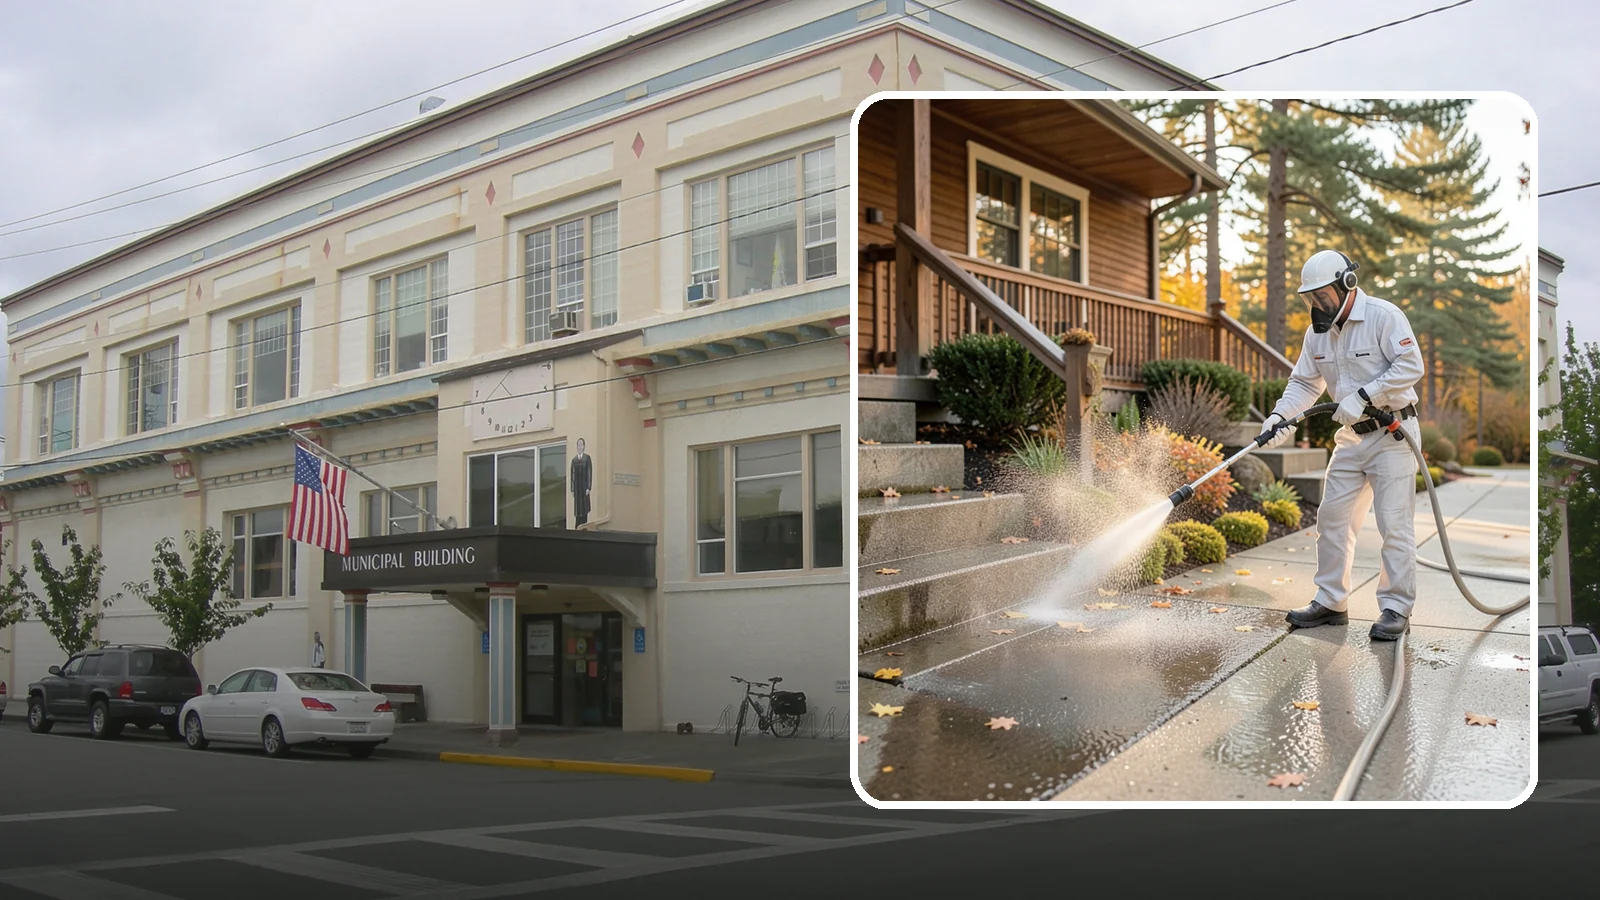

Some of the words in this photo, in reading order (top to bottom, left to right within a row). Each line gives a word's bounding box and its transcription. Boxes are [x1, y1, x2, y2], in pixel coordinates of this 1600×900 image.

[475, 390, 479, 398] 7
[536, 402, 540, 410] 4
[481, 407, 485, 415] 8
[488, 418, 492, 426] 9
[521, 420, 525, 428] 2
[494, 424, 500, 432] 10
[507, 425, 513, 433] 12
[342, 552, 405, 572] MUNICIPAL
[414, 546, 475, 567] BUILDING
